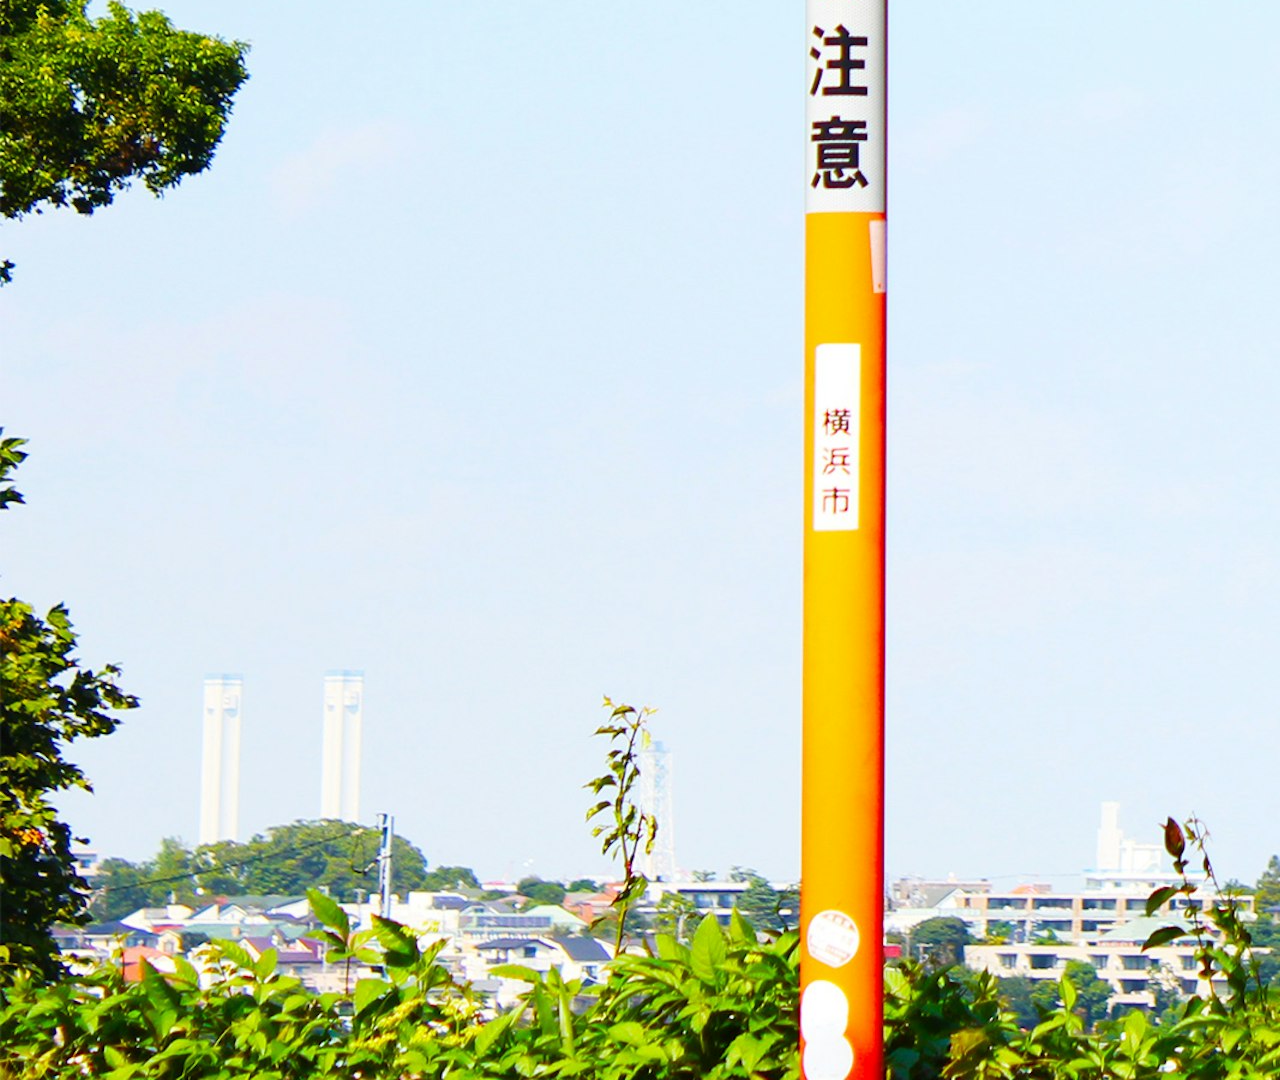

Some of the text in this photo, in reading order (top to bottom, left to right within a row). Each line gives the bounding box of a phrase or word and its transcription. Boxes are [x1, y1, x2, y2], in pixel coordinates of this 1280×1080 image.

[810, 24, 869, 188] 注意
[822, 408, 851, 514] 横浜市
